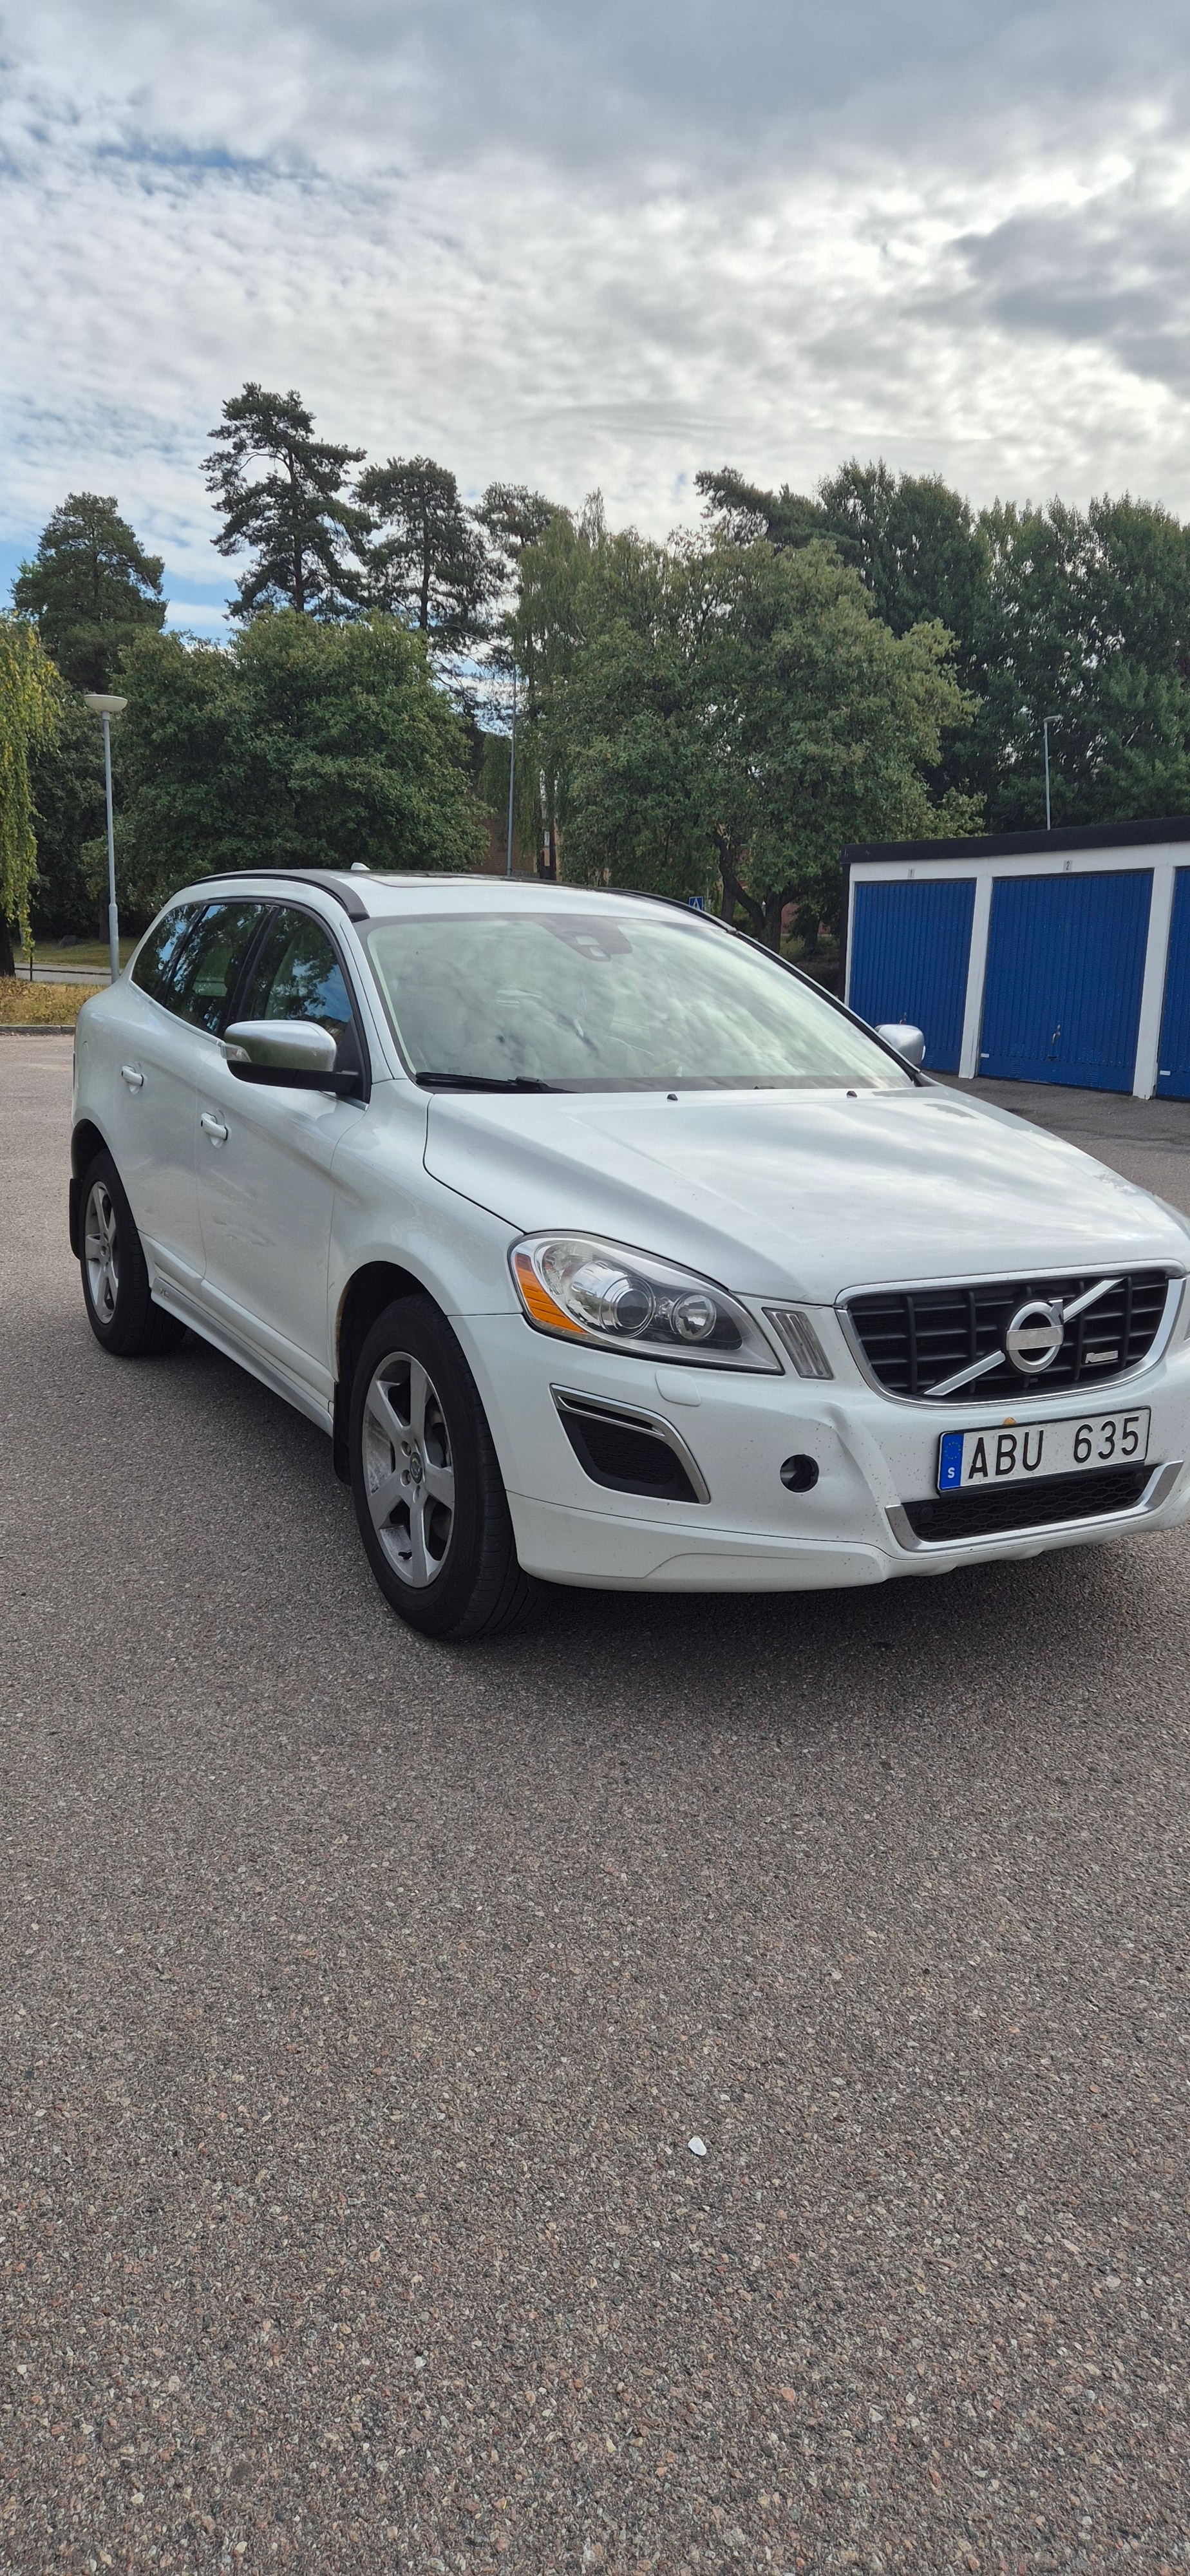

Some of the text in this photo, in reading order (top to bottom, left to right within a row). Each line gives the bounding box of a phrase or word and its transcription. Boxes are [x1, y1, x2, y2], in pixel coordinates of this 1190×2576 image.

[1066, 860, 1070, 871] 2
[968, 1416, 1140, 1479] ABU 635
[947, 1467, 956, 1479] S
